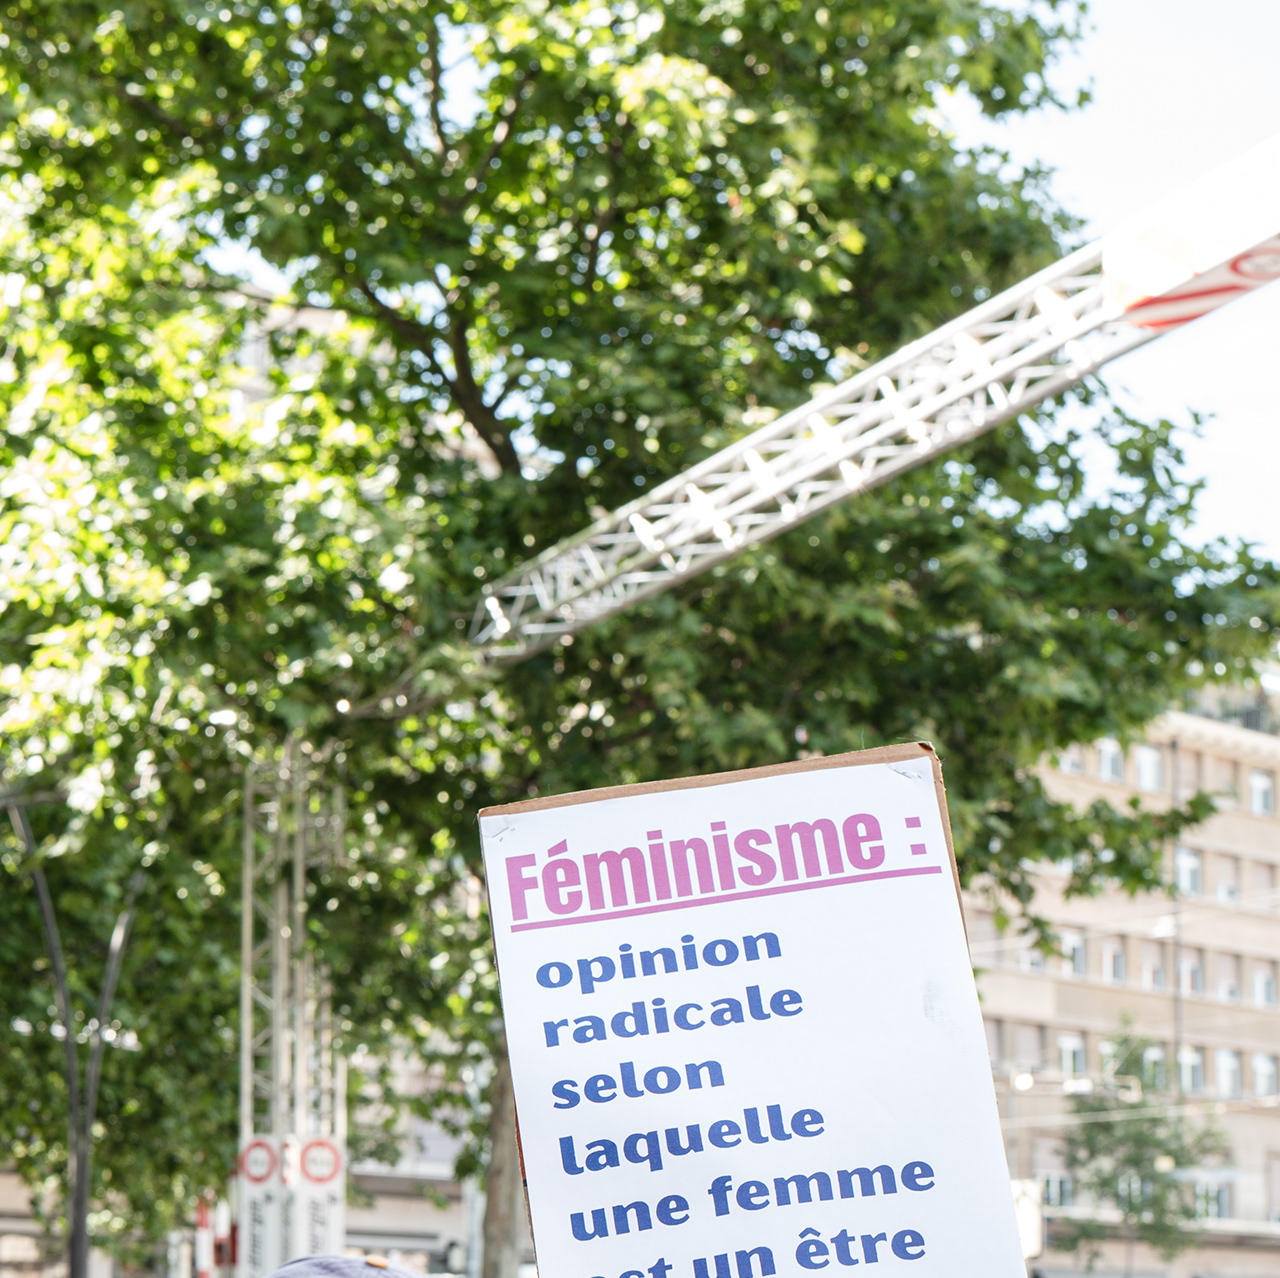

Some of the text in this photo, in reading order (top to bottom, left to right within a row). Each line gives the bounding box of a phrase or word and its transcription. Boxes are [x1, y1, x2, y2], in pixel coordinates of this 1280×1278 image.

[504, 812, 886, 920] Féminisme
[535, 930, 783, 995] opinion
[542, 984, 804, 1048] radicale
[551, 1059, 725, 1110] selon
[558, 1103, 826, 1173] laquelle
[570, 1160, 935, 1242] une femme
[795, 1227, 926, 1270] être
